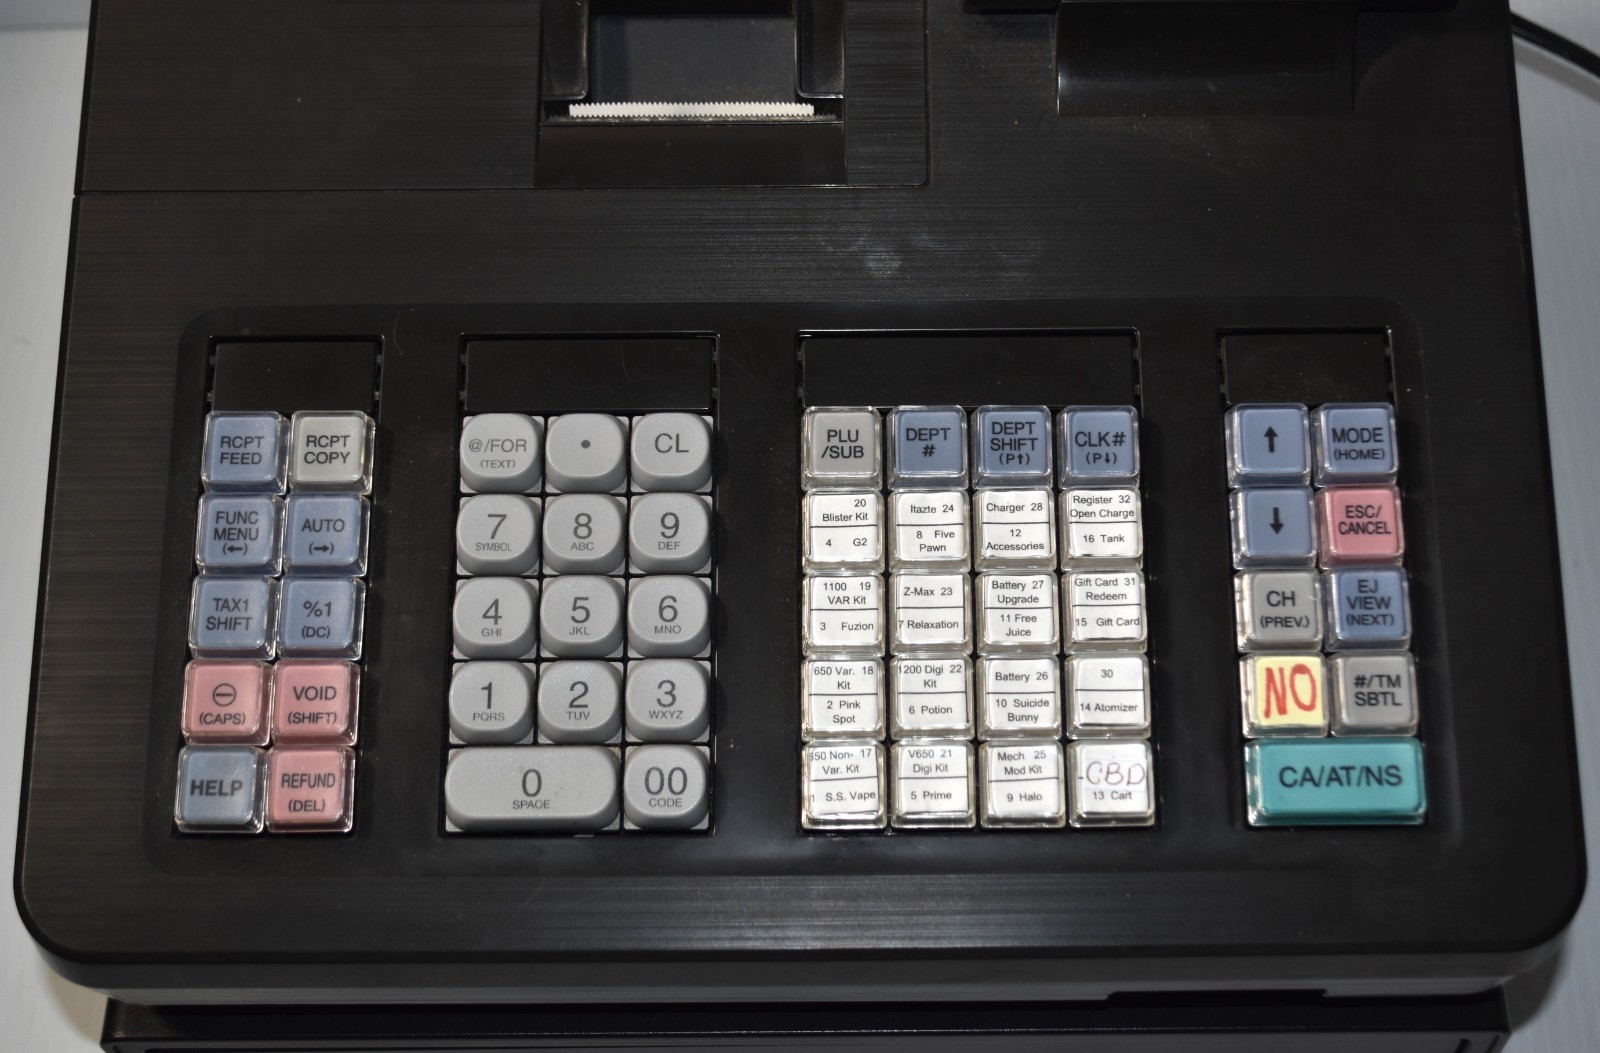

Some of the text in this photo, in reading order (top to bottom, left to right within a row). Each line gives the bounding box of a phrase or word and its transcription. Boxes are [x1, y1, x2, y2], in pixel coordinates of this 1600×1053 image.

[992, 422, 1036, 435] DEPT
[827, 429, 859, 442] PLU
[906, 428, 951, 441] DEPT
[1075, 432, 1126, 447] CLK#
[1332, 428, 1383, 443] MODE
[220, 436, 264, 448] RCPT
[306, 435, 350, 447] RCPT
[469, 439, 528, 453] @/FOR
[654, 433, 689, 453] CL
[990, 438, 1038, 451] SHIFT
[821, 446, 864, 458] /SUB
[922, 444, 935, 457] #
[1334, 449, 1385, 460] (HOME)
[220, 453, 262, 465] FEED
[304, 452, 350, 464] COPY
[480, 459, 515, 469] (TEXT)
[854, 499, 866, 507] 20
[1073, 495, 1130, 506] Register 32
[911, 504, 954, 513] Itazte 24
[987, 503, 1043, 513] Charger 28
[1346, 505, 1382, 518] ESC/
[216, 511, 259, 524] FUNC
[823, 513, 868, 522] Blister Kit
[1070, 509, 1134, 519] Open Charge
[302, 519, 345, 532] AUTO
[487, 513, 507, 539] 7
[573, 512, 592, 539] 8
[660, 512, 680, 539] 9
[1338, 522, 1391, 535] CANCEL
[214, 528, 259, 541] MENU
[917, 530, 955, 539] 8 Five
[1010, 529, 1021, 537] 12
[1100, 534, 1125, 542] Tank
[476, 542, 512, 551] SYMBOL
[571, 542, 594, 551] ABC
[658, 541, 681, 550] DEF
[826, 538, 867, 547] 4 G2
[986, 541, 1044, 550] Accessories
[823, 582, 871, 591] 1100 19
[992, 581, 1044, 591] Battery 27
[1075, 578, 1092, 587] Gift
[1095, 578, 1118, 586] Card
[1358, 579, 1378, 594] EJ
[904, 587, 935, 596] Z-Max
[1086, 592, 1127, 600] Redeem
[854, 596, 866, 604] Kit
[997, 595, 1039, 605] Upgrade
[1266, 591, 1295, 607] CH
[1346, 596, 1391, 610] VIEW
[213, 598, 249, 612] TAX1
[303, 601, 332, 617] %1
[570, 596, 591, 623] 5
[658, 595, 678, 622] 6
[482, 598, 502, 625] 4
[1015, 614, 1037, 622] Free
[1096, 618, 1113, 626] Gift
[1116, 618, 1140, 626] Card
[1260, 616, 1309, 628] (PREV.)
[1346, 614, 1394, 626] (NEXT)
[206, 617, 253, 631] SHIFT
[841, 622, 873, 630] Fuzion
[898, 620, 959, 629] 7 Relaxation
[302, 627, 331, 639] (DC)
[482, 628, 502, 637] GHI
[570, 627, 590, 636] JKL
[654, 625, 682, 634] MNO
[1006, 628, 1031, 636] Juice
[814, 667, 832, 675] 650
[835, 667, 855, 675] Var.
[925, 665, 944, 675] Digi
[950, 665, 962, 673] 22
[1101, 670, 1113, 678] 30
[995, 672, 1048, 683] Battery 26
[1354, 674, 1401, 688] #/TM
[837, 681, 850, 689] Kit
[924, 679, 936, 688] Kit
[293, 686, 337, 701] VOID
[481, 682, 493, 709] 1
[568, 681, 589, 709] 2
[656, 680, 676, 707] 3
[1264, 663, 1317, 718] NO
[996, 699, 1049, 707] 10 Suicide
[1355, 692, 1402, 706] SBTL
[827, 700, 861, 709] 2 Pink
[1080, 703, 1138, 712] 14 Atomizer
[649, 710, 683, 719] WXYZ
[909, 706, 952, 714] 6 Potion
[200, 712, 246, 725] (CAPS)
[288, 712, 337, 724] (SHIFT)
[473, 712, 505, 722] PQRS
[566, 711, 591, 720] TUV
[833, 715, 855, 725] Spot
[1008, 713, 1039, 723] Bunny
[830, 751, 853, 759] Non-
[861, 749, 872, 758] 17
[908, 749, 952, 758] V650 21
[998, 751, 1046, 760] Mech 25
[823, 764, 859, 774] Var. Kit
[913, 764, 948, 774] Digi Kit
[1004, 765, 1042, 775] Mod Kit
[1086, 761, 1145, 786] CBD
[281, 773, 335, 788] REFUND
[644, 766, 688, 795] 00
[1279, 765, 1402, 788] CA/AT/NS
[522, 768, 542, 797] 0
[190, 780, 243, 797] HELP
[825, 793, 846, 801] S.S.
[850, 791, 875, 800] Vape
[911, 791, 952, 800] 5 Prime
[1007, 792, 1042, 802] 9 Halo
[1093, 791, 1132, 800] 13 Cart
[289, 799, 325, 813] (DEL)
[512, 800, 550, 810] SPACE
[648, 798, 683, 808] CODE
